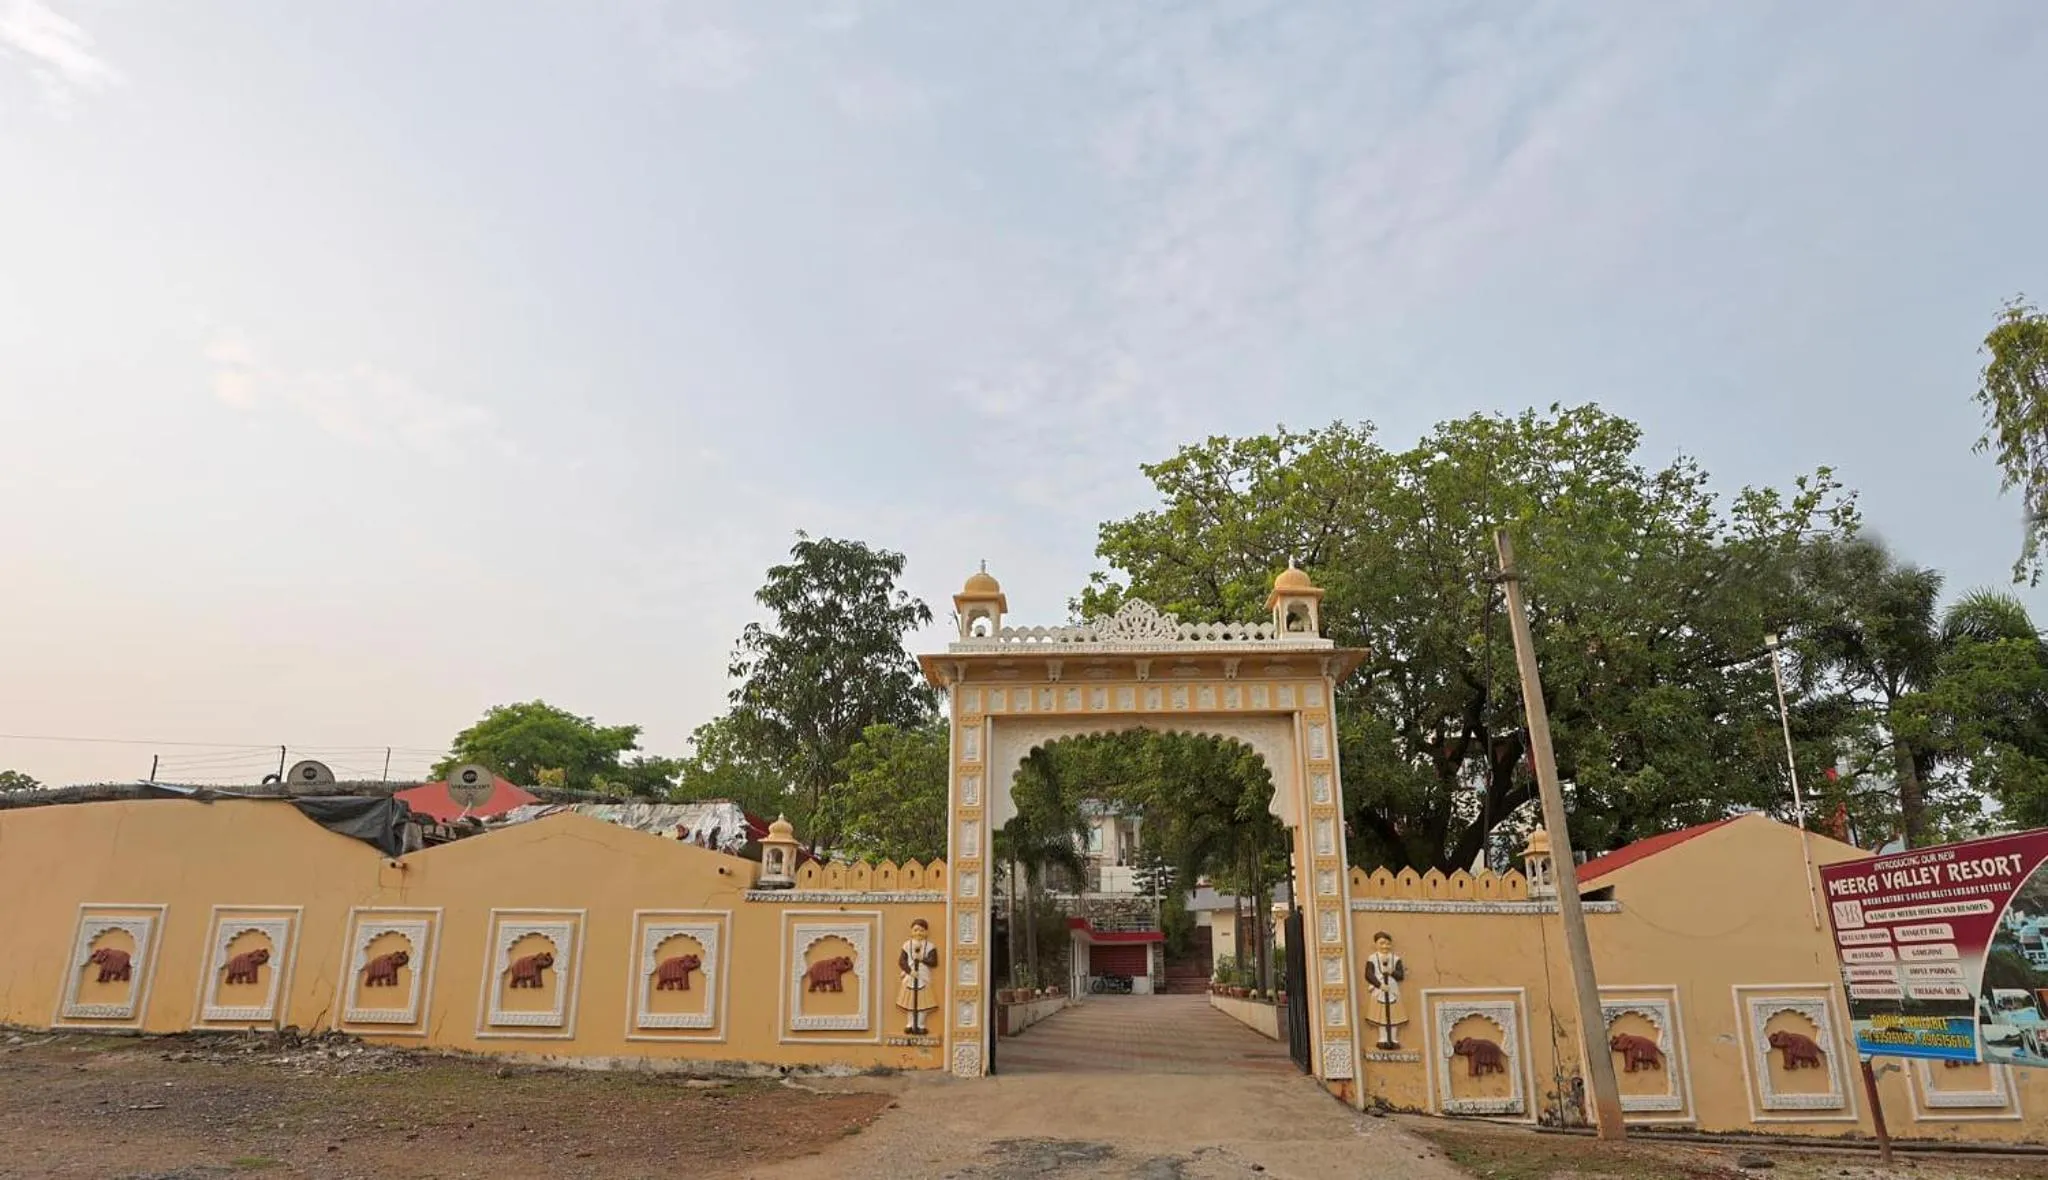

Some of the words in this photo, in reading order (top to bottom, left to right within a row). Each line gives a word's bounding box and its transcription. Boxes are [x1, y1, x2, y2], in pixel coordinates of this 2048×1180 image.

[1873, 856, 1920, 871] INTRODUCING
[1921, 854, 1936, 864] OUR
[1937, 850, 1956, 862] NEW
[1828, 874, 1879, 897] MEERA
[1881, 866, 1941, 890] VALLEY
[1946, 854, 2022, 883] RESORT
[1931, 888, 1952, 900] MEETS
[1980, 881, 2012, 894] RETREAT
[1943, 906, 1956, 915] AND
